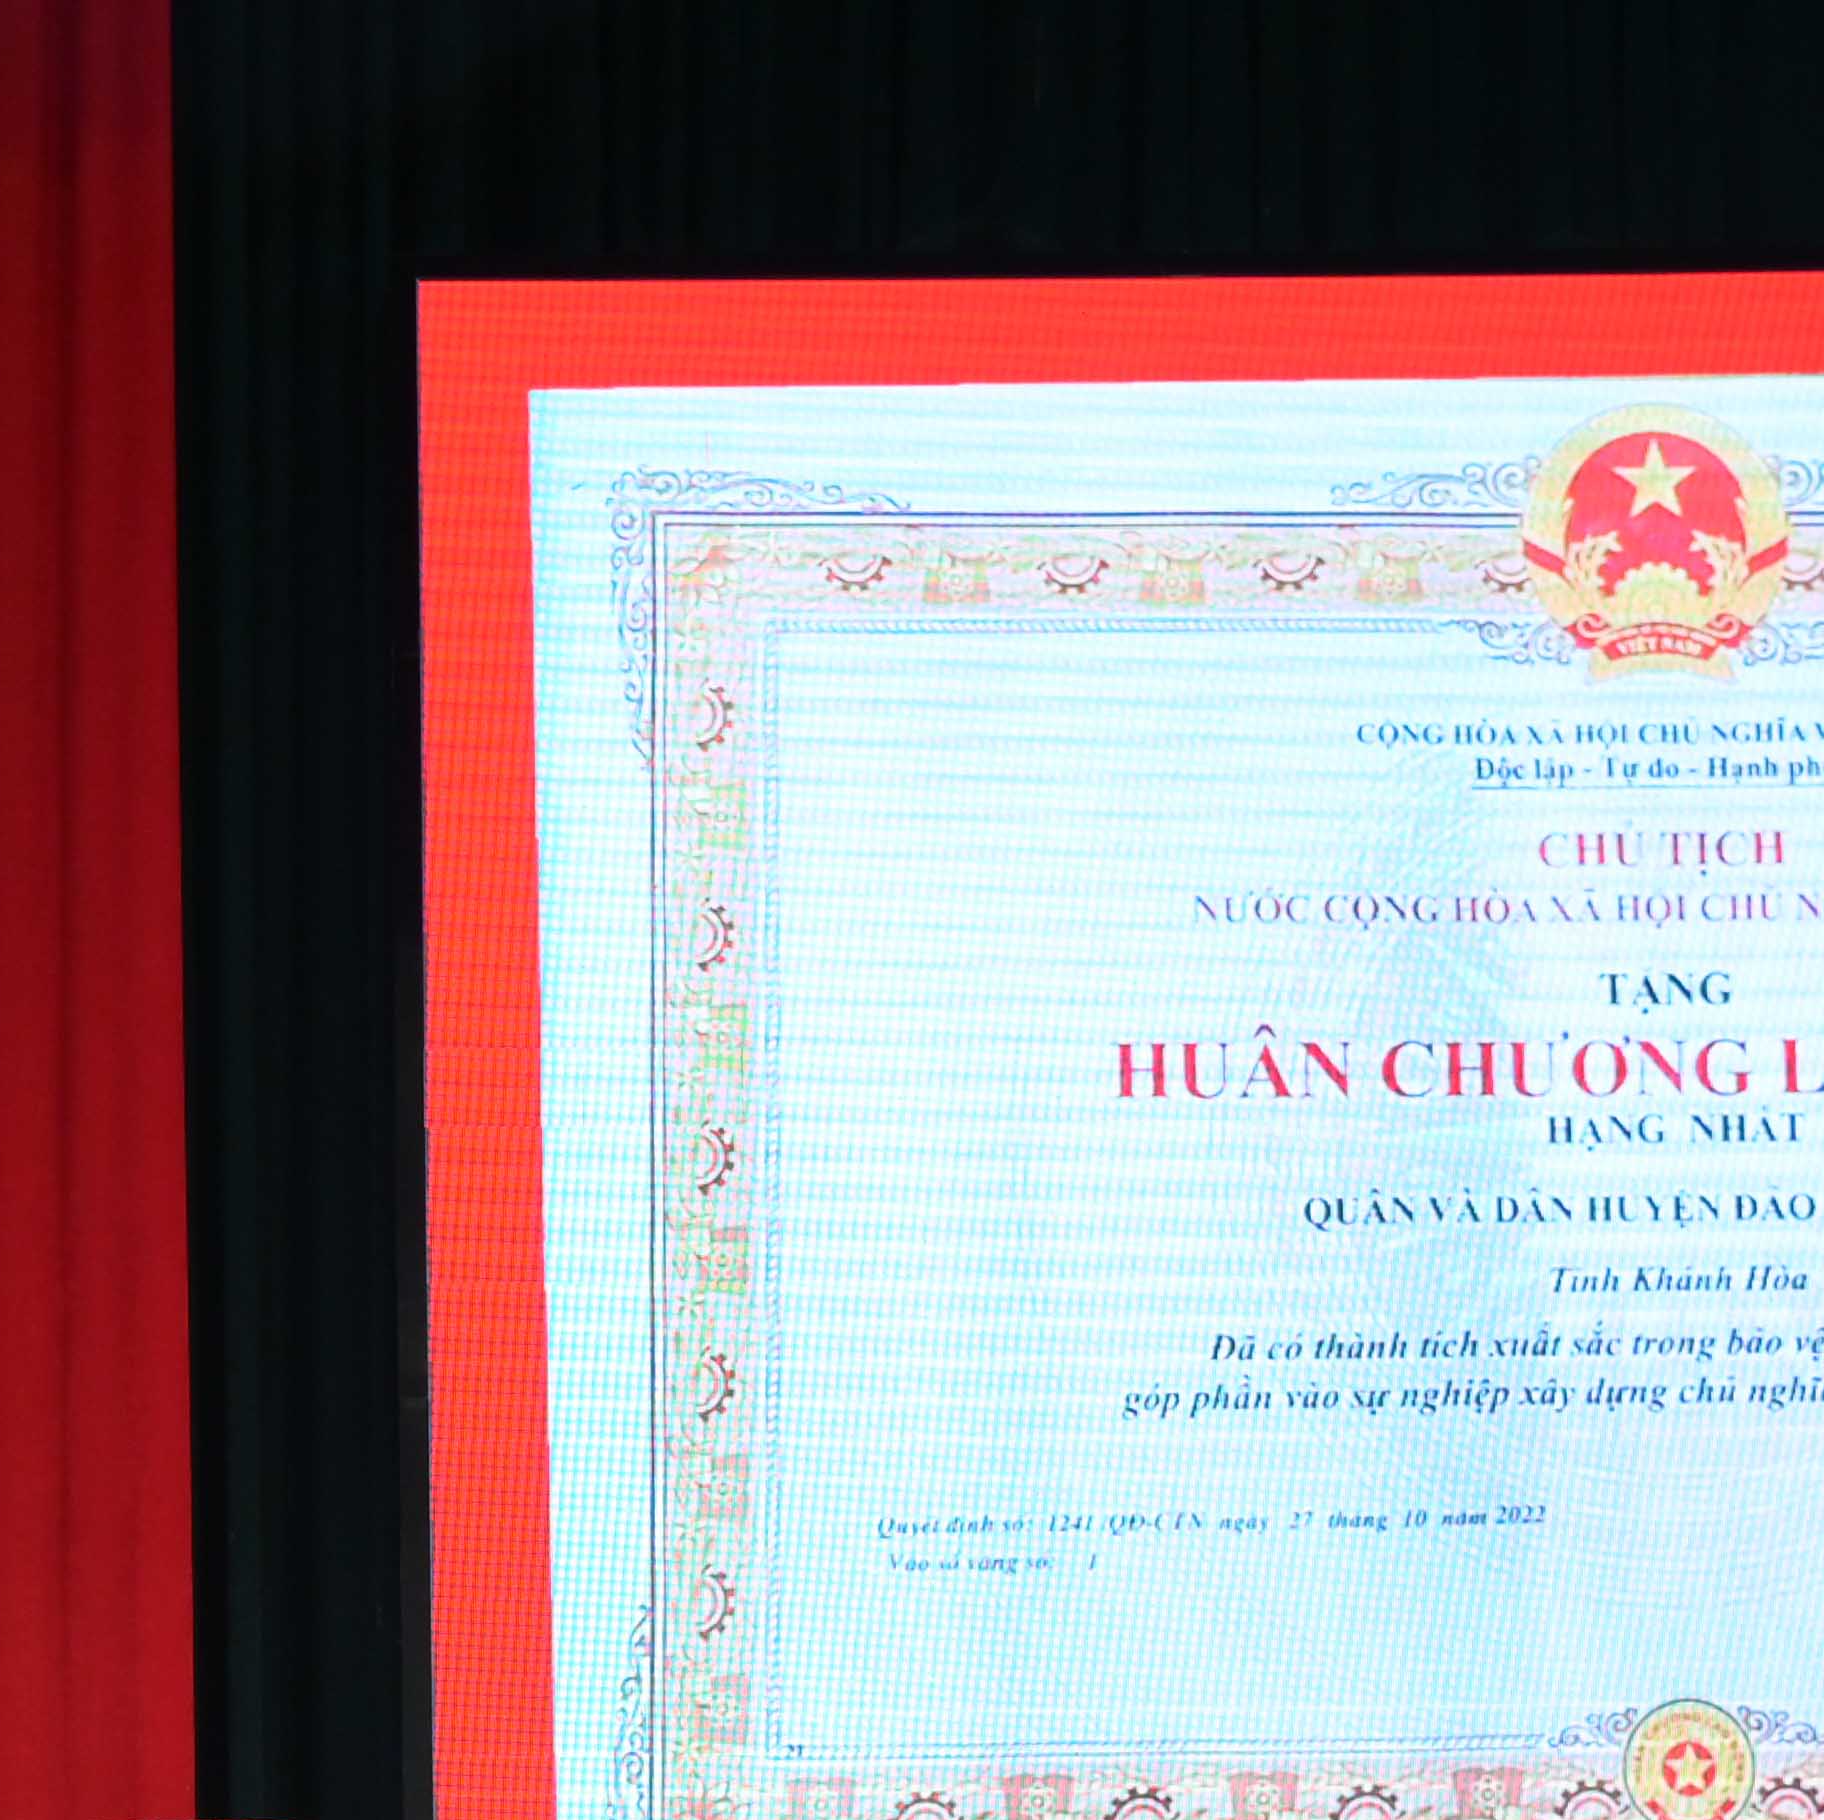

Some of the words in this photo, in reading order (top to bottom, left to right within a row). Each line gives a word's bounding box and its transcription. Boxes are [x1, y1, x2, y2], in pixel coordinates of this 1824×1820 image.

[1357, 719, 1444, 750] CỘNG
[1454, 718, 1516, 745] HÒA
[1527, 719, 1565, 745] XÃ
[1576, 719, 1628, 750] HỘI
[1638, 717, 1700, 744] CHỦ
[1711, 717, 1806, 744] NGHĨA
[1476, 756, 1524, 788] Độc
[1534, 757, 1574, 788] lập
[1605, 757, 1638, 785] Tự
[1648, 757, 1679, 778] do
[1708, 755, 1778, 784] Hạnh
[1539, 819, 1644, 868] CHỦ
[1659, 830, 1785, 876] TỊCH
[1193, 888, 1311, 925] NƯỚC
[1324, 889, 1438, 931] CỘNG
[1454, 887, 1537, 923] HÒA
[1549, 888, 1601, 923] XÃ
[1617, 889, 1687, 929] HỘI
[1701, 884, 1781, 921] CHỦ
[1600, 967, 1732, 1015] TẶNG
[1110, 1023, 1350, 1099] HUÂN
[1381, 1030, 1753, 1098] CHƯƠNG
[1547, 1113, 1666, 1151] HẠNG
[1690, 1106, 1805, 1143] NHẤT
[1304, 1188, 1416, 1232] QUÂN
[1428, 1187, 1482, 1223] VÀ
[1495, 1187, 1573, 1223] DÂN
[1588, 1188, 1719, 1229] HUYỆN
[1735, 1185, 1817, 1221] ĐẢO
[1550, 1264, 1620, 1293] Tỉnh
[1633, 1264, 1732, 1293] Khánh
[1745, 1263, 1809, 1292] Hòa
[1211, 1333, 1256, 1361] Đã
[1267, 1332, 1303, 1361] có
[1313, 1331, 1407, 1361] thành
[1419, 1329, 1478, 1359] tích
[1489, 1321, 1561, 1358] xuất
[1574, 1319, 1622, 1357] sắc
[1631, 1332, 1717, 1362] trong
[1727, 1328, 1783, 1356] bảo
[1121, 1383, 1180, 1420] góp
[1190, 1374, 1273, 1418] phần
[1287, 1383, 1340, 1410] vào
[1349, 1387, 1389, 1415] sự
[1399, 1378, 1510, 1415] nghiệp
[1519, 1377, 1576, 1414] xây
[1585, 1376, 1668, 1413] dựng
[1678, 1375, 1736, 1404] chủ
[1289, 1510, 1313, 1530] 27
[1404, 1508, 1427, 1528] 10
[1495, 1504, 1547, 1525] 2022
